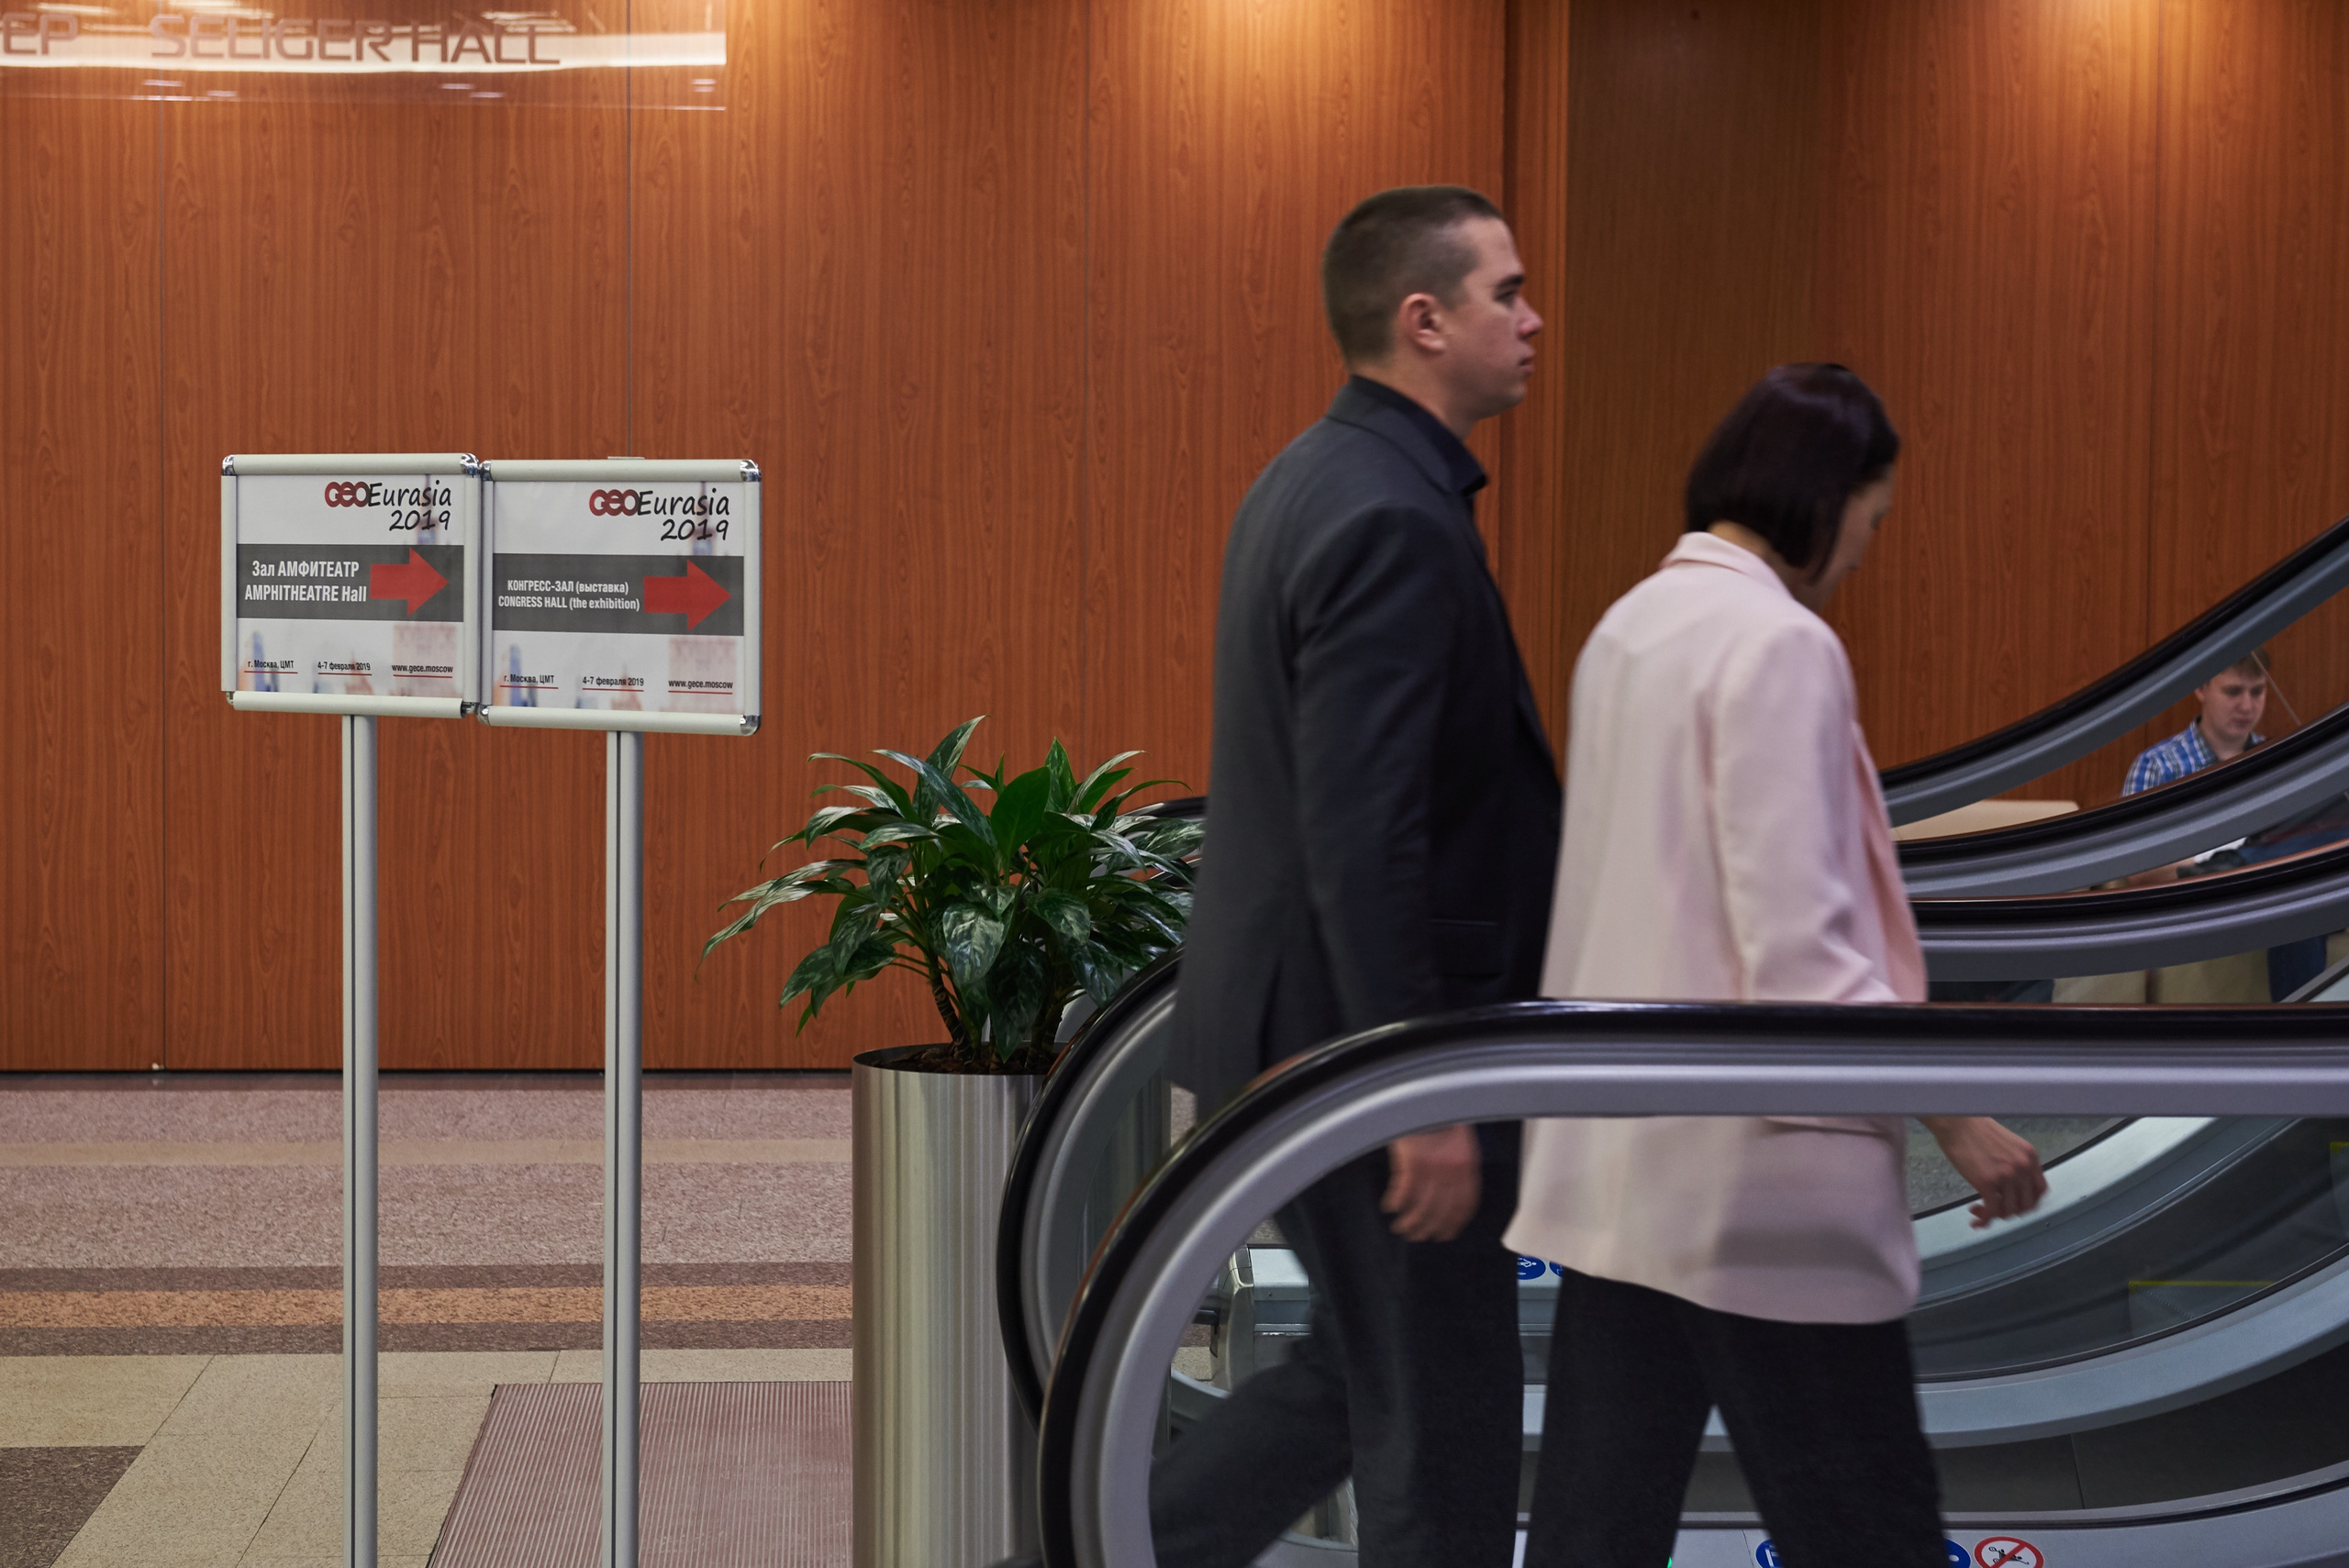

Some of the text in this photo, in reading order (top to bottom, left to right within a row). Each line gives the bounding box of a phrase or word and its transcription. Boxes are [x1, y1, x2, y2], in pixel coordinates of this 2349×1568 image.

[150, 14, 561, 64] SELIGER HALL
[389, 509, 451, 531] 2019
[661, 518, 729, 541] 2019
[251, 560, 360, 578] Зал АМФИТЕАТР
[245, 584, 367, 602] AMPHITHEATRE Hall
[507, 579, 629, 595] КОНГРЕСС-ЗАЛ (выставка)
[498, 595, 640, 612] CONGRESS HALL (the exhibition)
[254, 660, 280, 670] Москва,
[280, 660, 295, 670] ЦМТ
[317, 661, 371, 672] 4-7 февраля 2019
[392, 663, 453, 674] www.gece.moscow
[510, 673, 539, 684] Москва,
[539, 674, 554, 684] ЦМТ
[582, 676, 644, 687] 4-7 февраля 2019
[668, 679, 733, 690] www.gece.moscow
